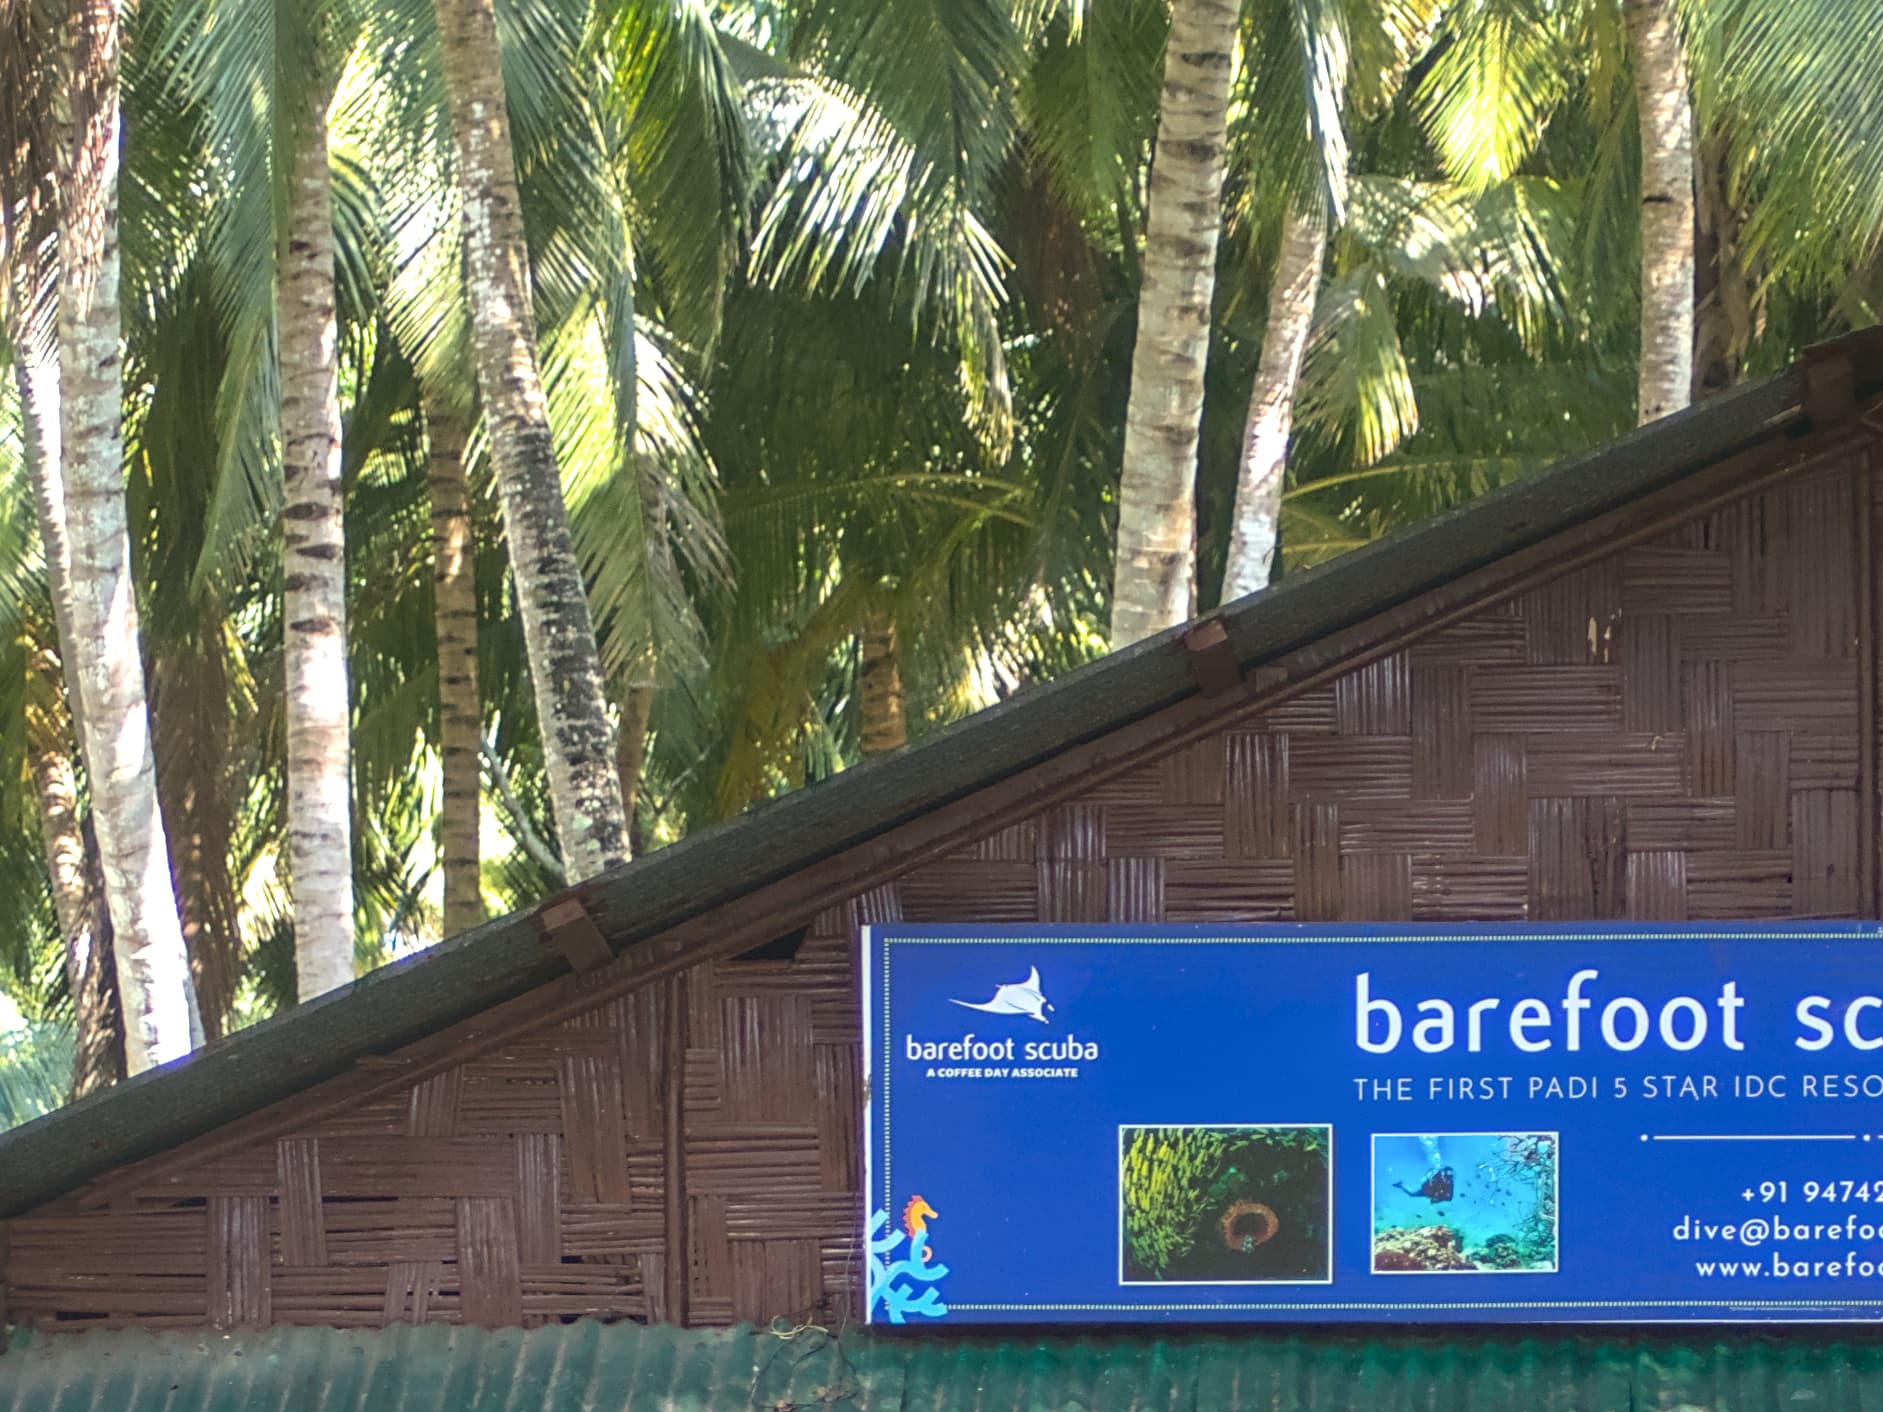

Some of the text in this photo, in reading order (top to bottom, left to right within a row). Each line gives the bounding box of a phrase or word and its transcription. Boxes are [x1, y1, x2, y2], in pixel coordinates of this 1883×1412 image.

[1355, 969, 1746, 1054] barefoot
[905, 1033, 1099, 1060] barefoot scuba
[926, 1067, 1079, 1078] A COFFEE DAY ASSOCIATE
[1354, 1077, 1412, 1100] THE
[1429, 1076, 1512, 1099] FIRST
[1529, 1076, 1597, 1099] PADI
[1614, 1076, 1627, 1098] 5
[1643, 1075, 1719, 1099] STAR
[1734, 1075, 1787, 1098] IDC
[1742, 1181, 1788, 1203] +91
